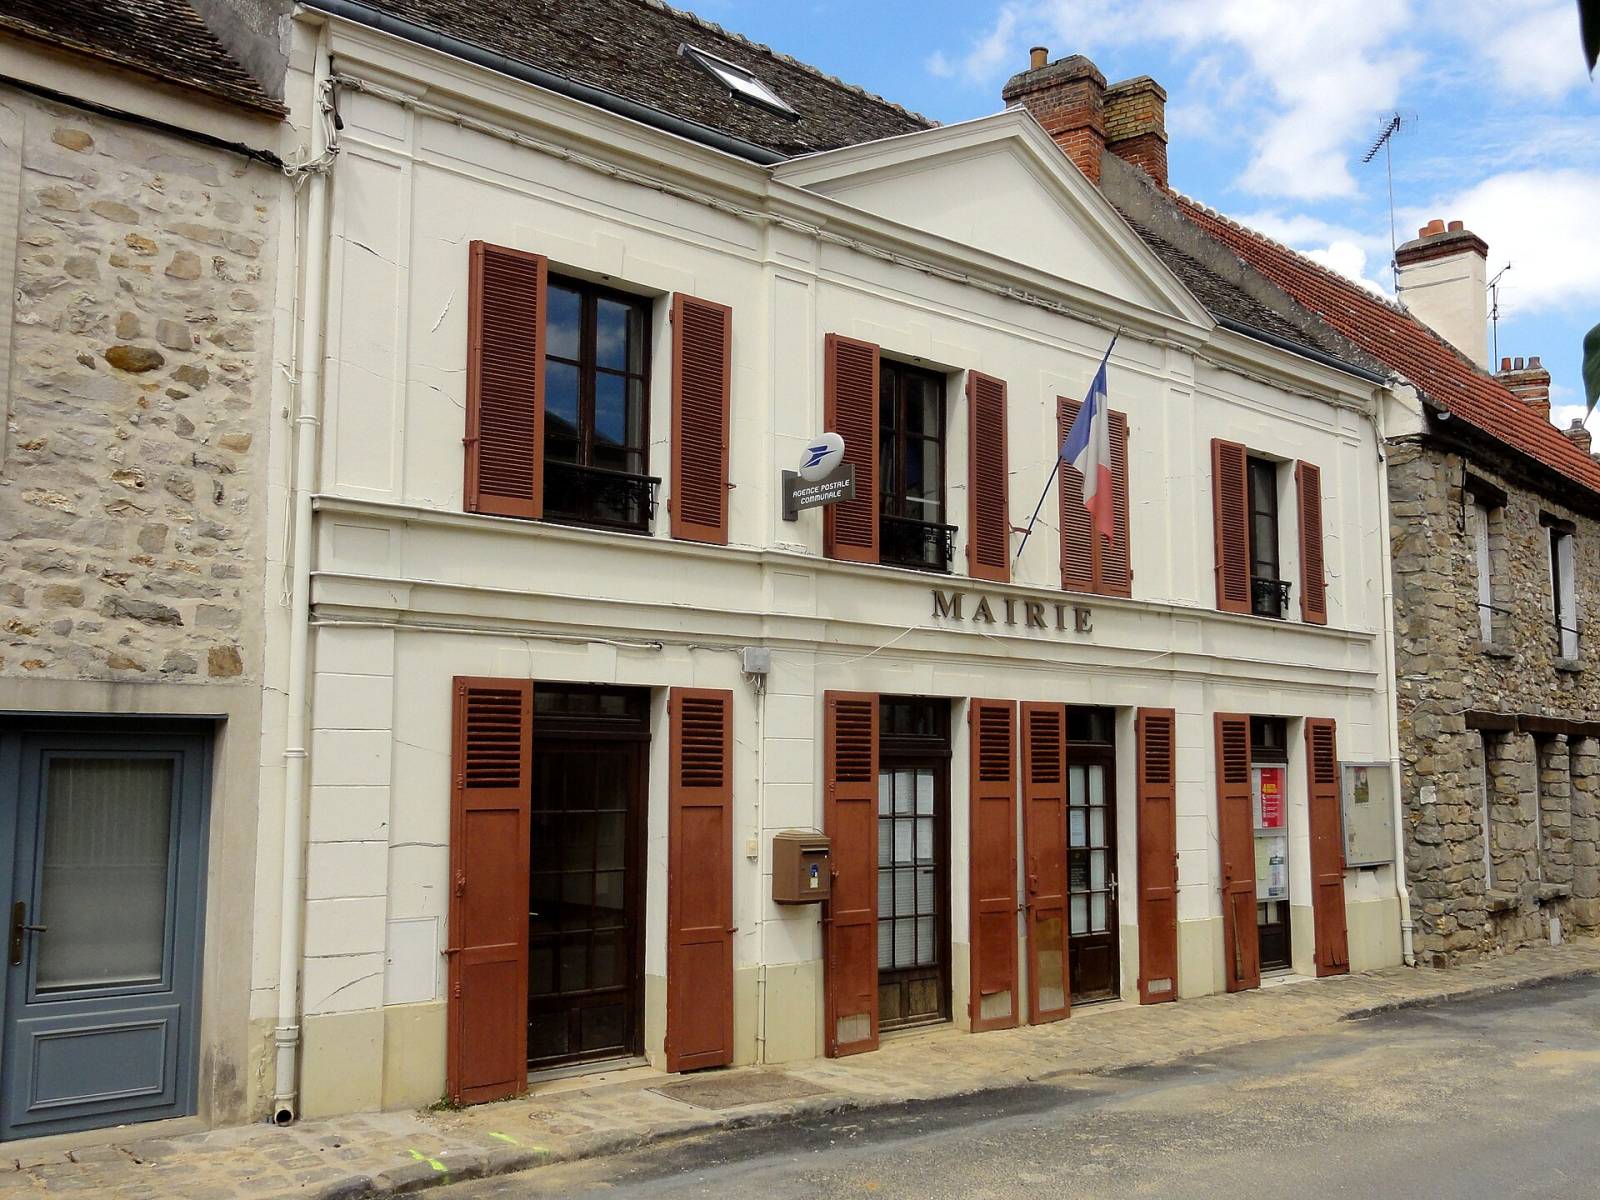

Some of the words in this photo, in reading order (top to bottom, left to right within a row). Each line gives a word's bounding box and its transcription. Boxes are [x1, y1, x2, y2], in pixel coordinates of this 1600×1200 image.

[792, 486, 819, 498] AGENCE
[820, 479, 850, 491] POSTALE
[800, 490, 841, 504] COMMUNALE
[931, 589, 1094, 633] MAIRIE
